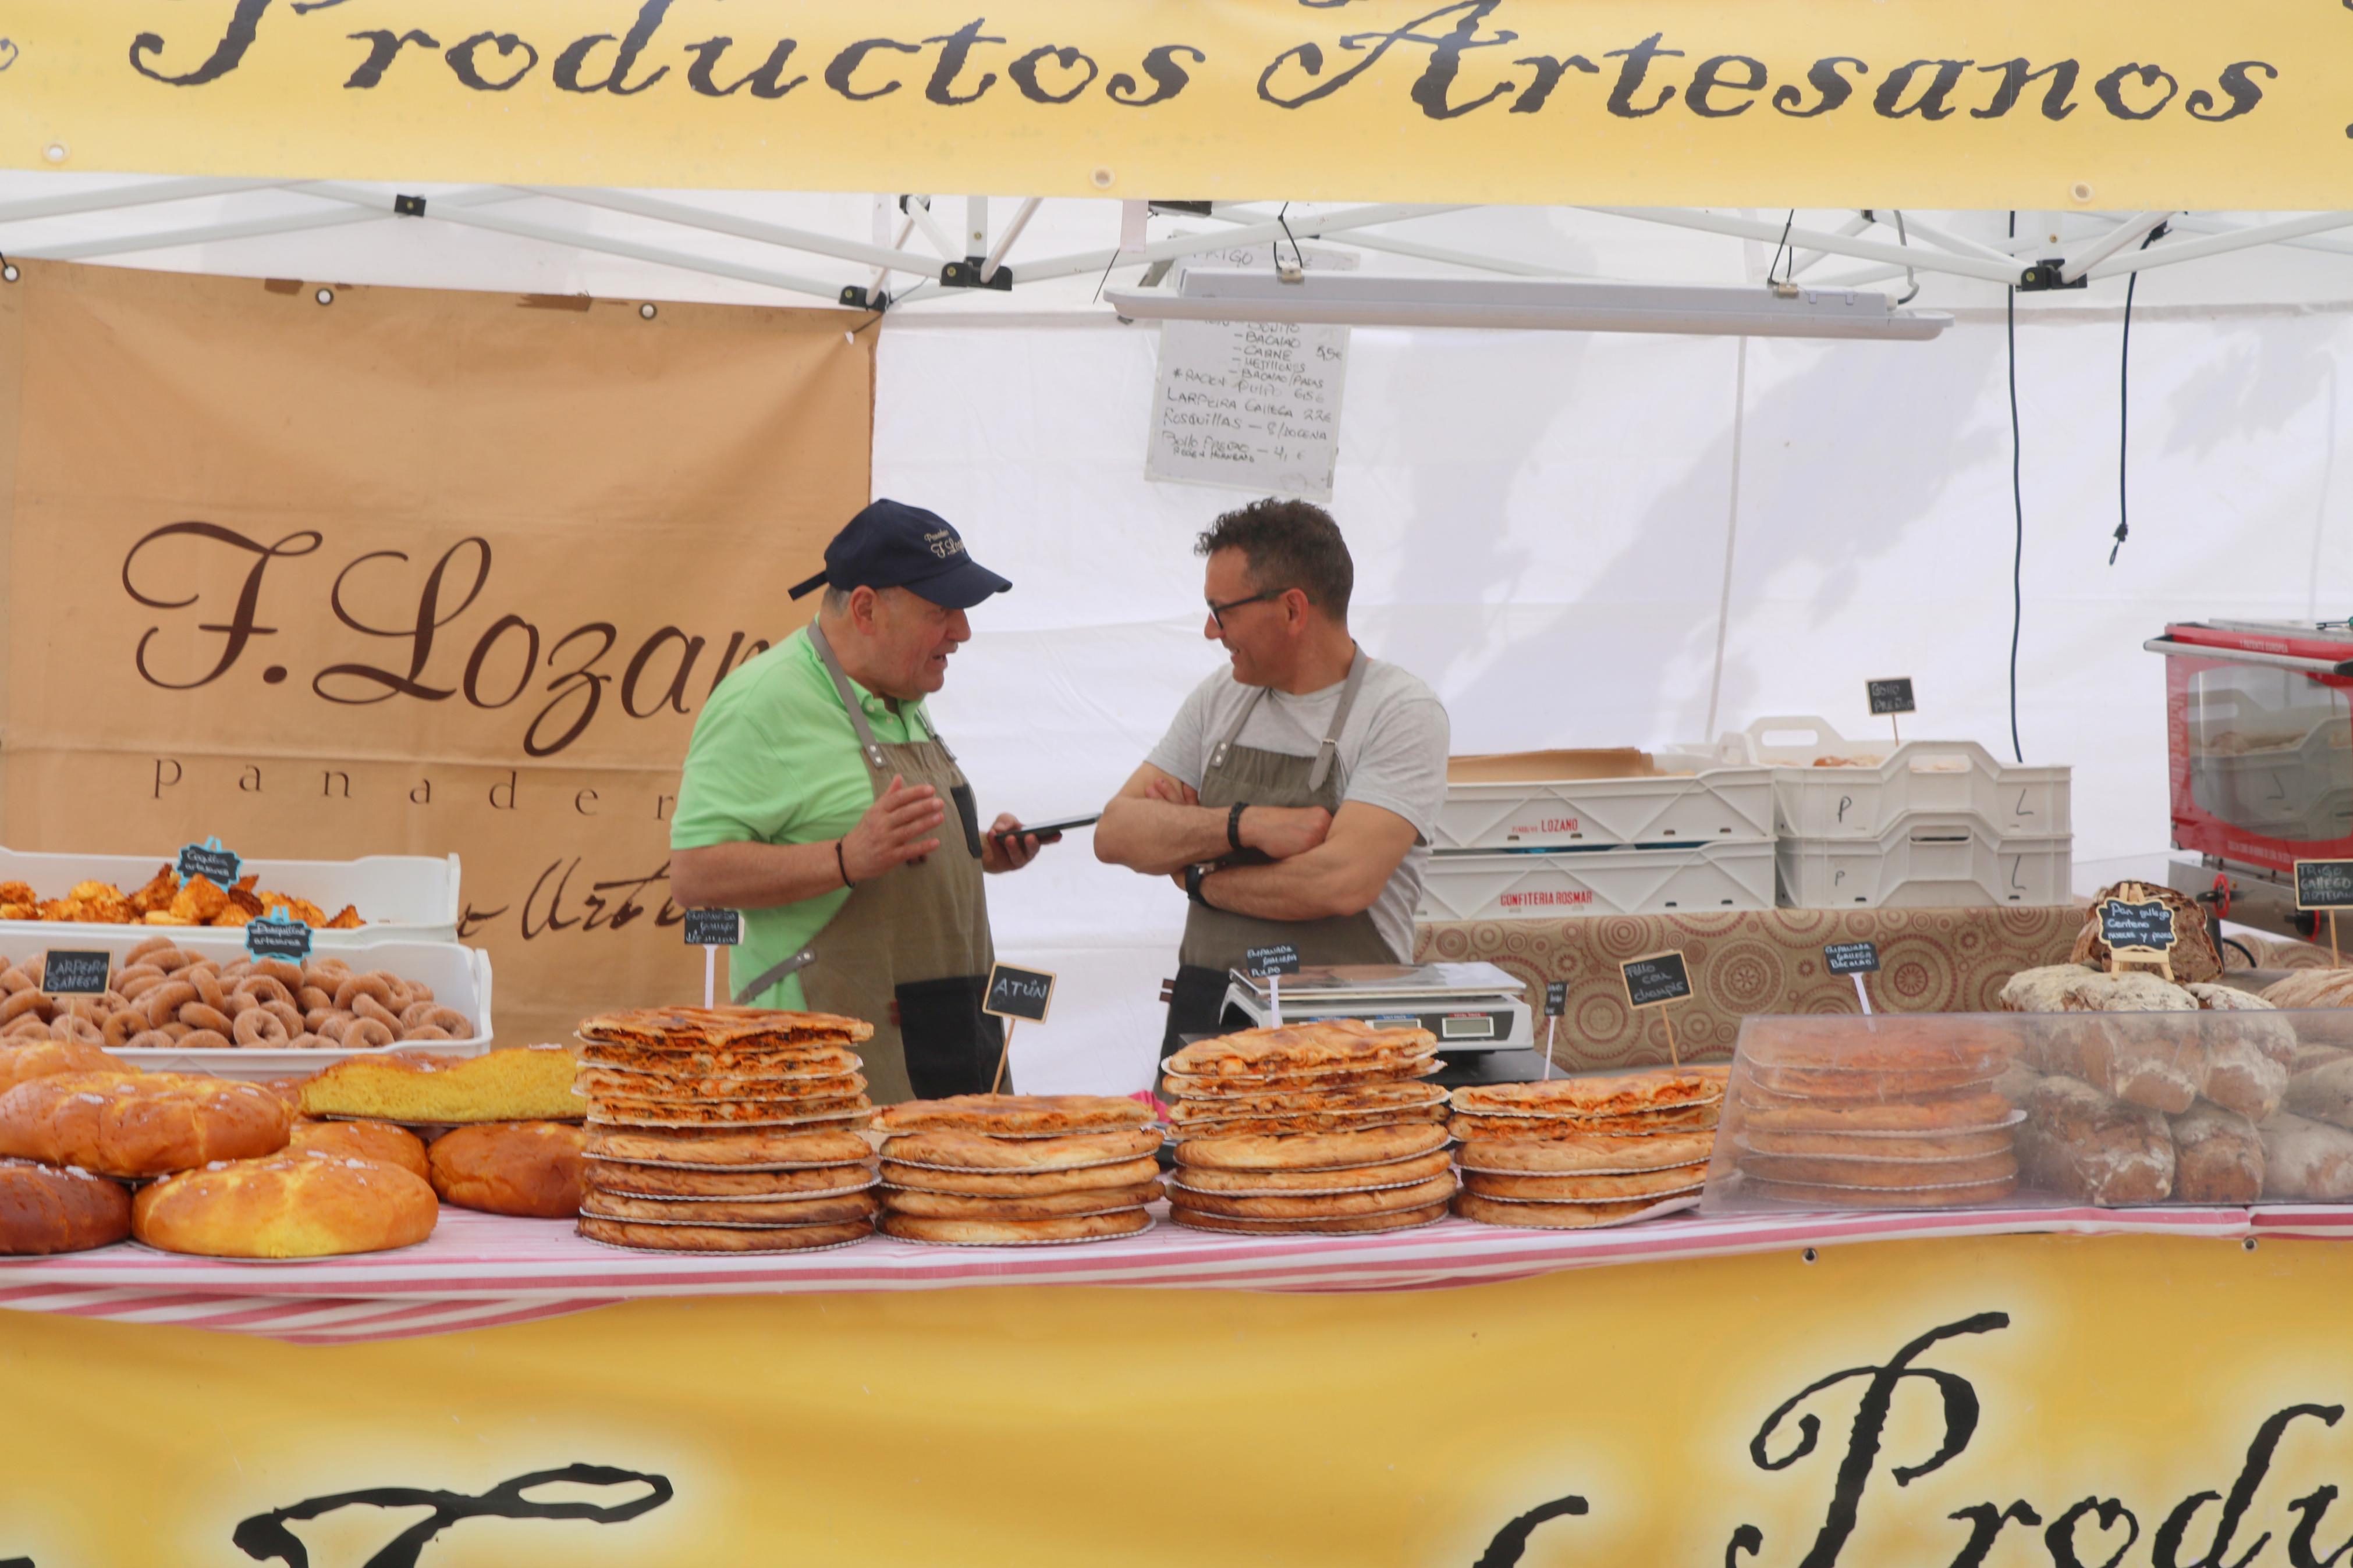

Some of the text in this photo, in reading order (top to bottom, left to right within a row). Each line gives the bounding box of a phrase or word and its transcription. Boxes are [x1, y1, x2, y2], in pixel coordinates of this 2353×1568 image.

[1257, 0, 2279, 122] Artesanos
[152, 758, 673, 820] panader
[1541, 818, 1578, 833] LOZANO
[2298, 865, 2343, 880] TRIGO
[1500, 890, 1593, 906] CONFITERIA ROSMAR
[2110, 902, 2134, 917] Pan
